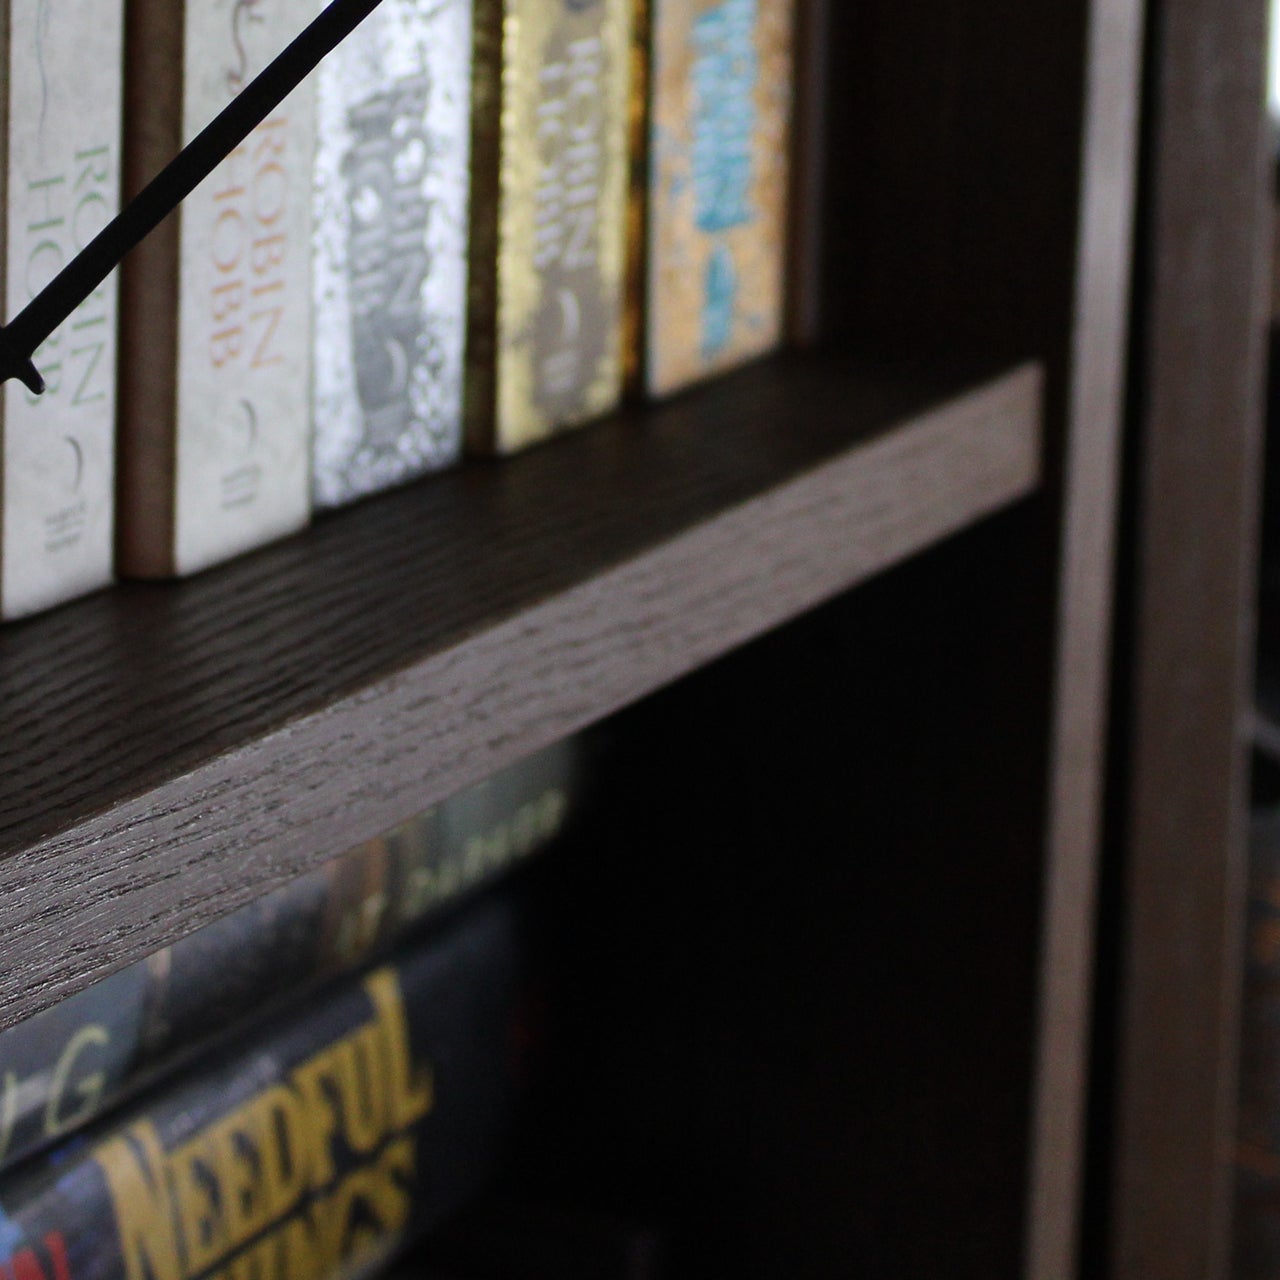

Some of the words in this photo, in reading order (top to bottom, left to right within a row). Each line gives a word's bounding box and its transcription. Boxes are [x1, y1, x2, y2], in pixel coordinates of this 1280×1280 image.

[73, 145, 110, 406] ROIN
[210, 146, 246, 370] HOBB
[250, 117, 288, 369] ROBIN
[92, 966, 432, 1280] NEEDFUL
